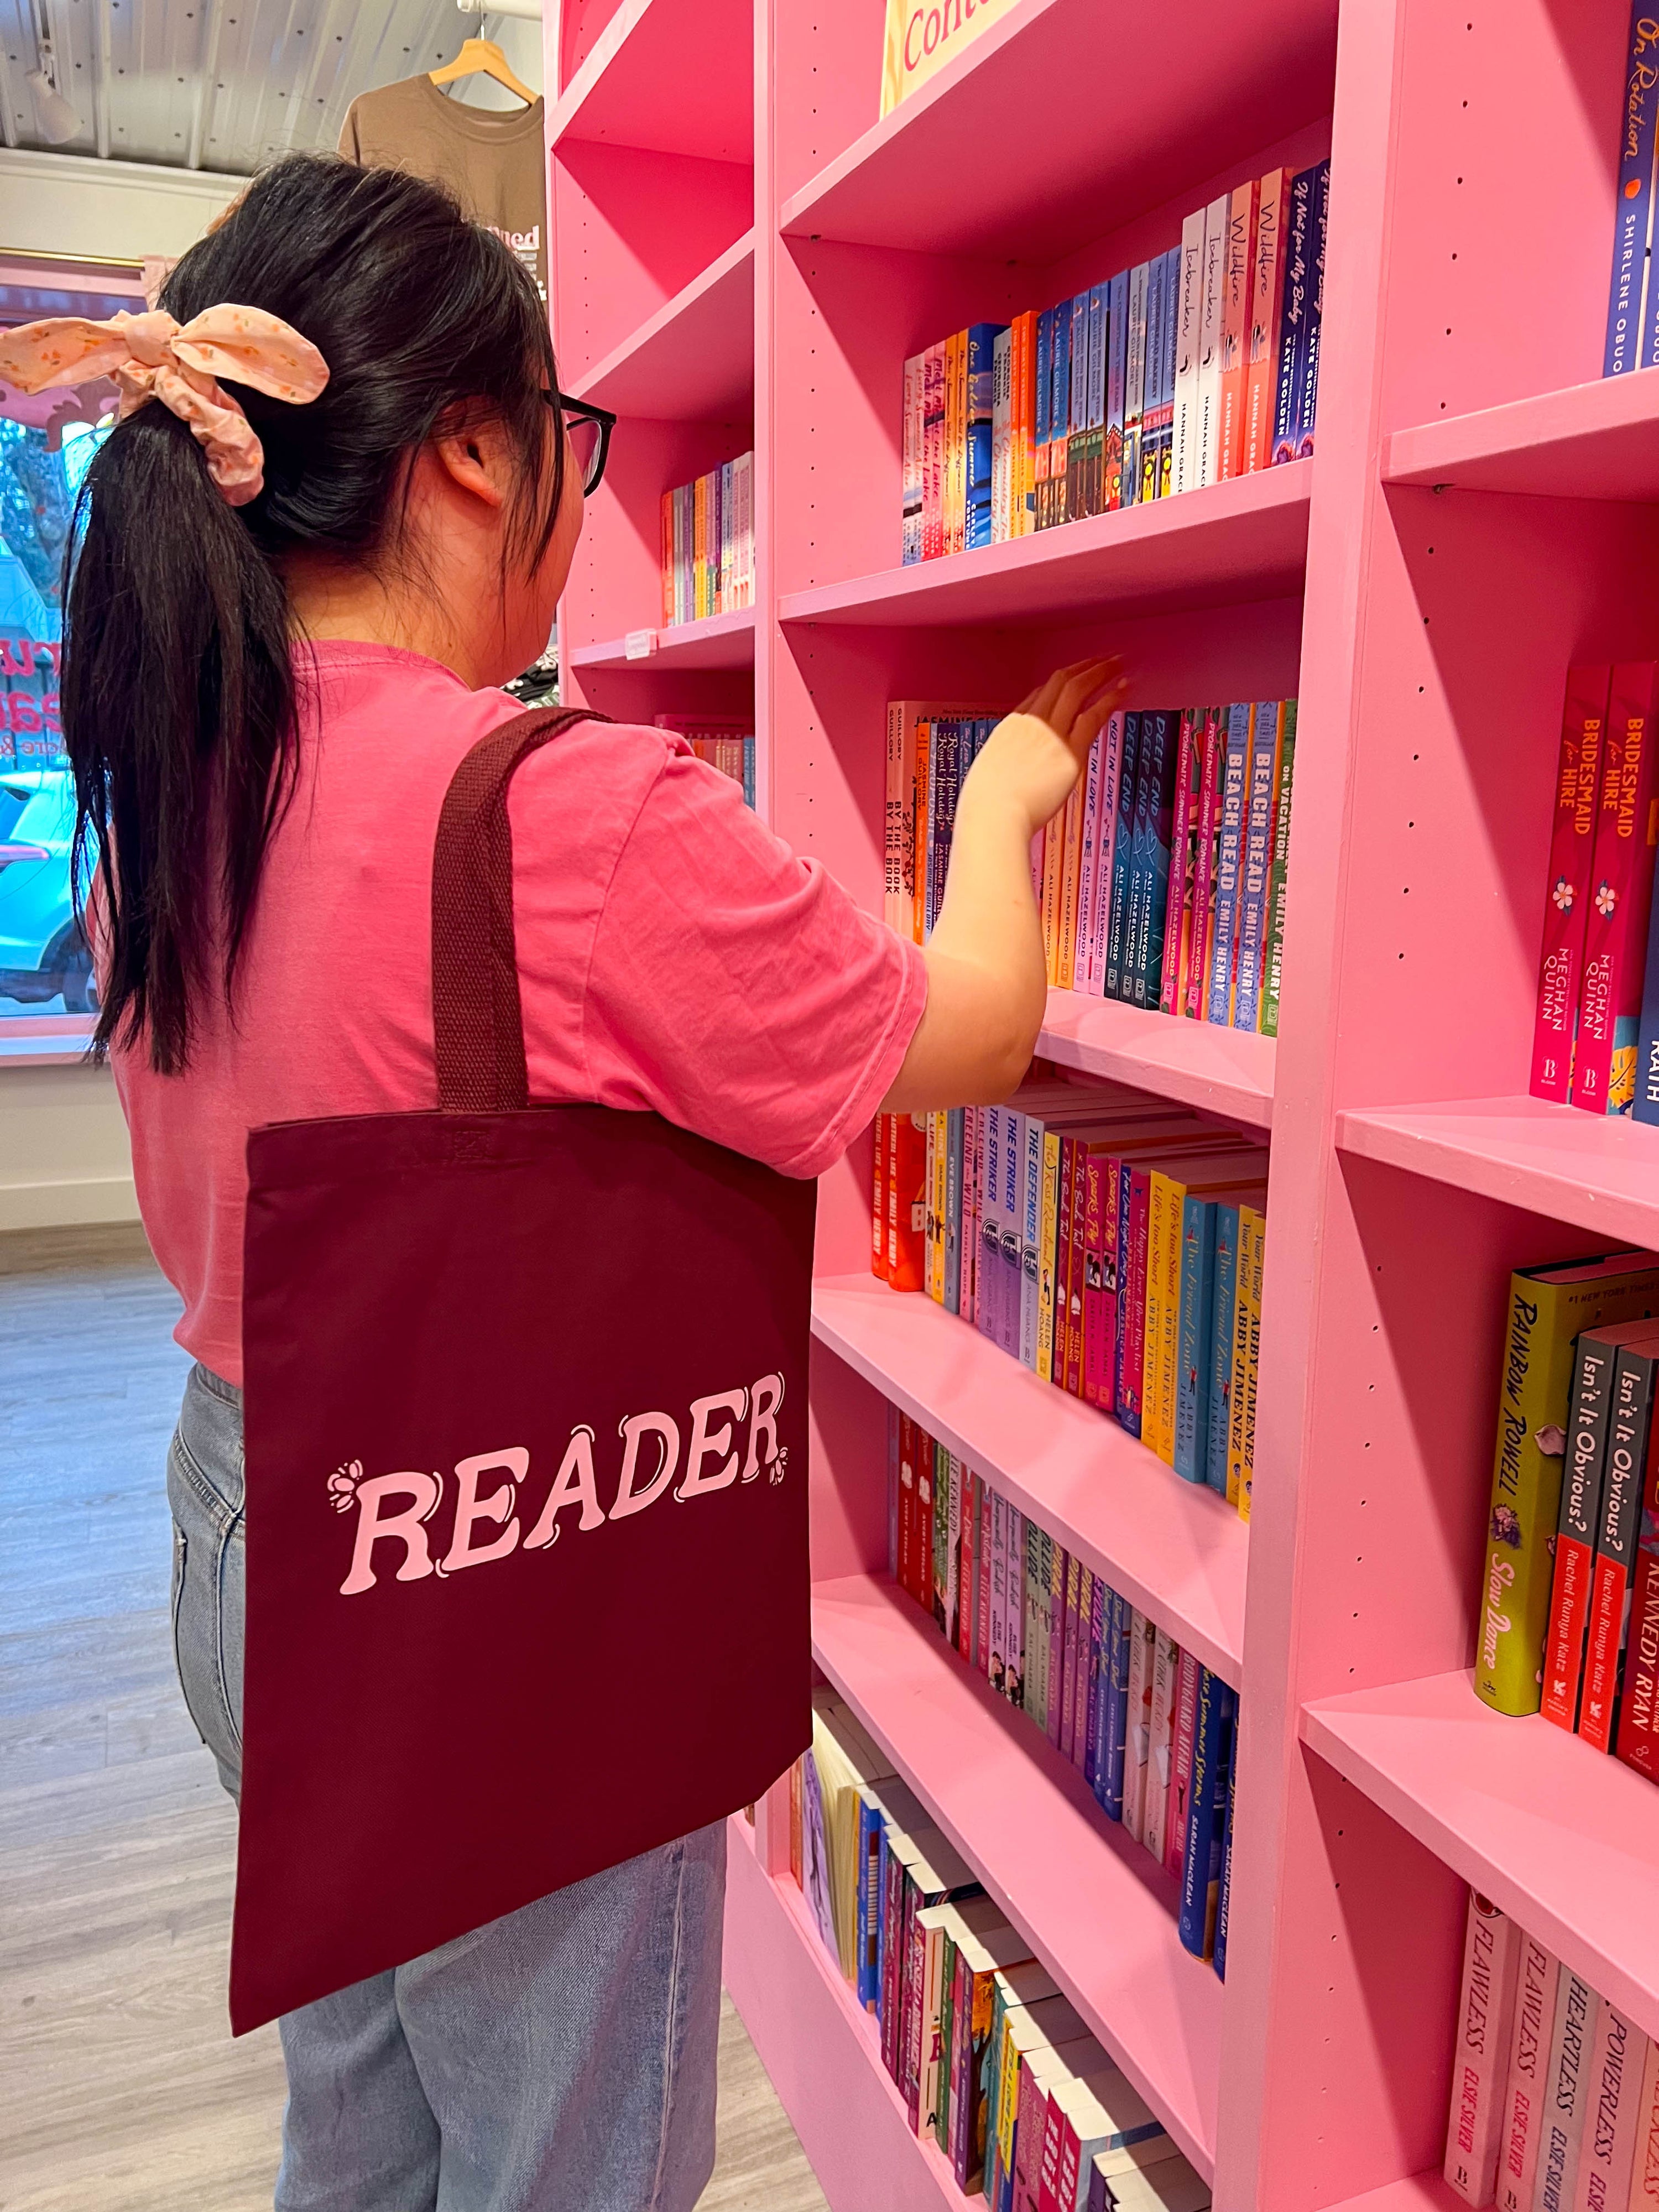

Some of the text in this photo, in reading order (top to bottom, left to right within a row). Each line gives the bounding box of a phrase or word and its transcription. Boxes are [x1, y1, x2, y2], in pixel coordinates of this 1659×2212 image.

[904, 0, 991, 71] Con
[1625, 18, 1659, 161] On Rotation
[1231, 213, 1246, 307] Wildfire
[1258, 200, 1275, 298] Wildfire
[1292, 230, 1305, 254] for
[1297, 201, 1307, 231] Not
[1183, 243, 1199, 337] Icebreaker
[1206, 232, 1220, 328] Icebreaker
[1288, 285, 1304, 325] Baby
[1290, 254, 1305, 285] My
[1618, 214, 1636, 311] SHIRLENE
[968, 375, 979, 426] Golden
[969, 341, 980, 368] One
[1302, 326, 1317, 429] KATE GOLDEN
[1279, 379, 1288, 436] GOLDEN
[936, 732, 947, 825] Royal Holiday
[946, 732, 958, 825] Royal Holiday
[1107, 775, 1115, 816] LOVE
[1109, 755, 1115, 772] IN
[1121, 716, 1136, 812] DEEP END
[1139, 719, 1153, 817] DEEP END
[1151, 716, 1165, 816] DEEP END
[1560, 739, 1578, 808] for HIRE
[1575, 719, 1600, 834] BRIDESMAID
[1603, 739, 1622, 811] for HIRE
[1616, 718, 1644, 838] BRIDESMAID
[886, 801, 894, 819] BY
[894, 801, 901, 819] BY
[1220, 753, 1243, 890] BEACH READ
[1248, 753, 1271, 893] BEACH READ
[1276, 765, 1290, 860] ON VACATION
[1081, 887, 1089, 957] HAZELWOOD
[1098, 886, 1107, 958] HAZELWOOD
[1113, 888, 1123, 961] HAZELWOOD
[1128, 894, 1139, 968] HAZELWOOD
[1141, 895, 1151, 971] HAZELWOOD
[1169, 907, 1179, 977] HAZELWOOD
[1194, 910, 1204, 982] HAZELWOOD
[1214, 900, 1231, 992] EMILY HENRY
[1241, 902, 1258, 997] EMILY HENRY
[1270, 882, 1287, 1000] EMILY HENRY
[1542, 955, 1557, 1020] QUINN
[1552, 948, 1570, 1031] MEGHAN
[1583, 961, 1599, 1029] QUINN
[1593, 954, 1610, 1040] MEGHAN
[988, 1107, 998, 1202] THE STRIKER
[1006, 1116, 1017, 1213] THE STRIKER
[1026, 1128, 1039, 1243] THE DEFENDER
[1087, 1165, 1099, 1245] Sparks Fly
[1151, 1185, 1163, 1286] Life's too Short
[1169, 1233, 1177, 1255] too
[1170, 1193, 1180, 1231] Life's
[1168, 1256, 1177, 1297] Short
[1240, 1222, 1251, 1289] Your World
[1252, 1234, 1263, 1302] Your World
[1165, 1306, 1173, 1345] ABBY
[1145, 1342, 1155, 1416] JIMENEZ
[1162, 1354, 1171, 1428] JIMENEZ
[1178, 1382, 1186, 1452] JIMENEZ
[1232, 1299, 1248, 1452] ABBY JIMENEZ
[1244, 1312, 1260, 1469] ABBY JIMENEZ
[1499, 1293, 1538, 1496] RAINBOW ROWELL
[339, 1374, 781, 1595] READER
[1568, 1355, 1604, 1533] Isn't It Obvious?
[1606, 1371, 1641, 1552] Isn't It Obvious?
[1483, 1553, 1515, 1670] Slow Dance
[1556, 1549, 1579, 1673] Rachel Runya Katz
[1592, 1568, 1616, 1694] Rachel Runya Katz
[1632, 1562, 1659, 1732] KENNEDY RYAN
[1176, 1652, 1195, 1780] BODYGUARD AFFAIR
[1194, 1668, 1215, 1806] hese Summer Storms
[1185, 1815, 1199, 1907] SARAH MACLEAN
[1465, 1919, 1494, 2055] FLAWLESS
[1517, 1941, 1547, 2079] FLAWLESS
[1556, 1976, 1588, 2117] HEARTLESS
[1594, 2013, 1627, 2165] POWERLESS
[1458, 2067, 1479, 2153] ELSIE SILVER
[1508, 2090, 1530, 2178] ELSIE SILVER
